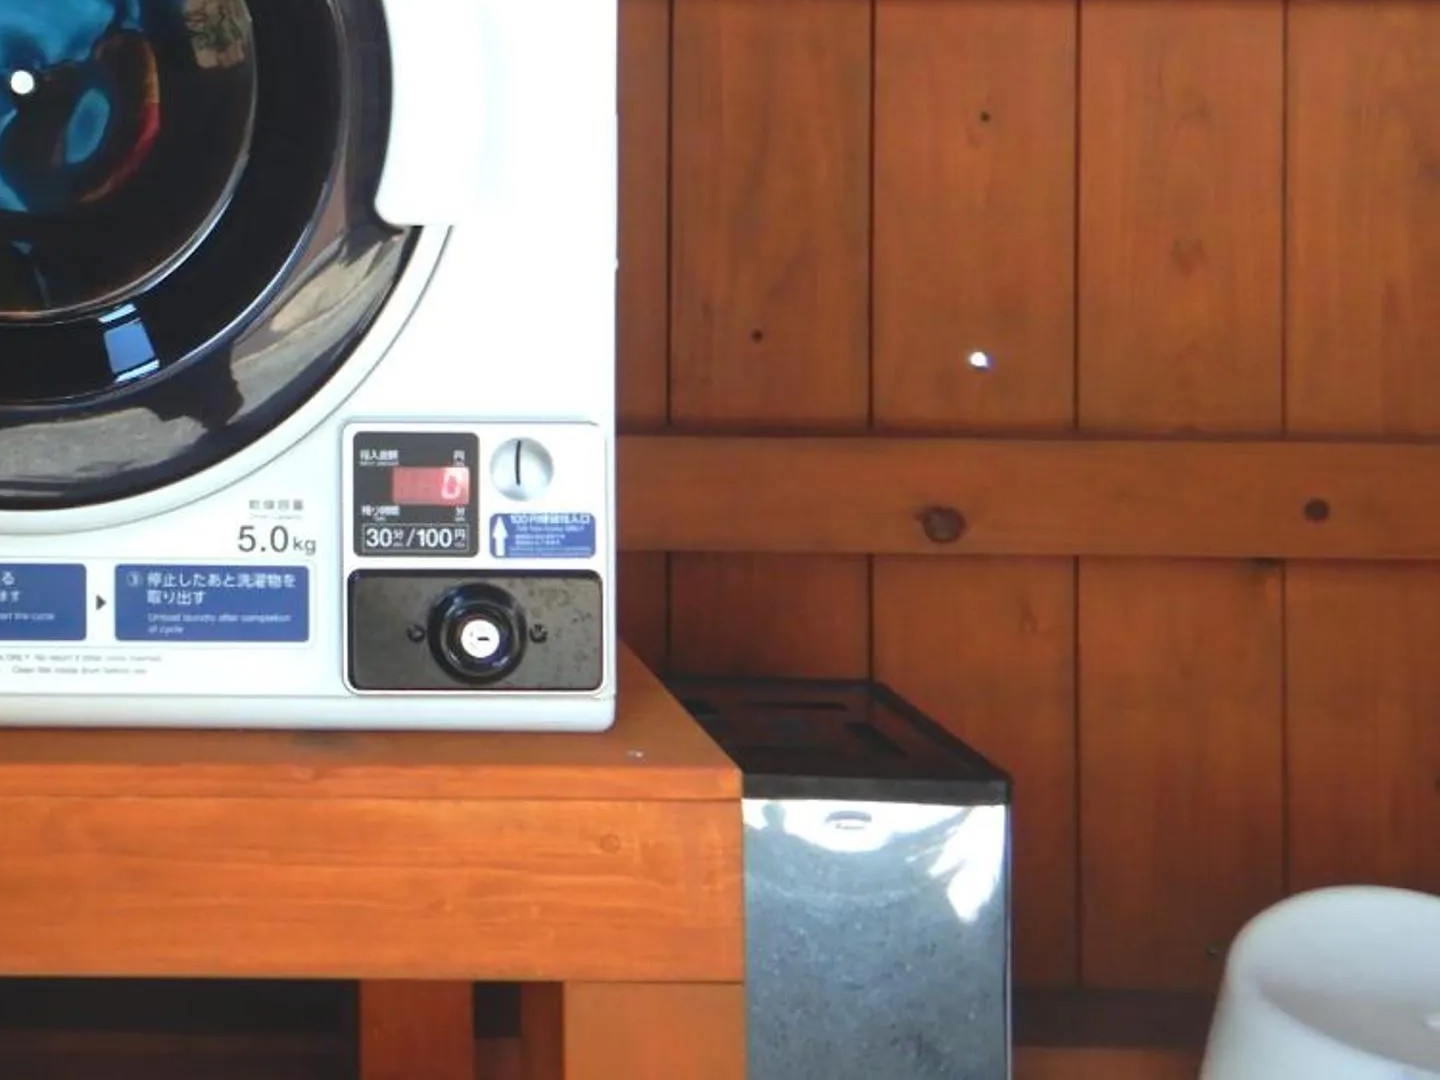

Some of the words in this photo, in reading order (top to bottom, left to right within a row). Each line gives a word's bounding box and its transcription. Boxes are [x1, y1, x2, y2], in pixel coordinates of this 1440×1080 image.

[147, 572, 297, 589] 停止したあと洗濯物を
[147, 590, 206, 605] 取り出す
